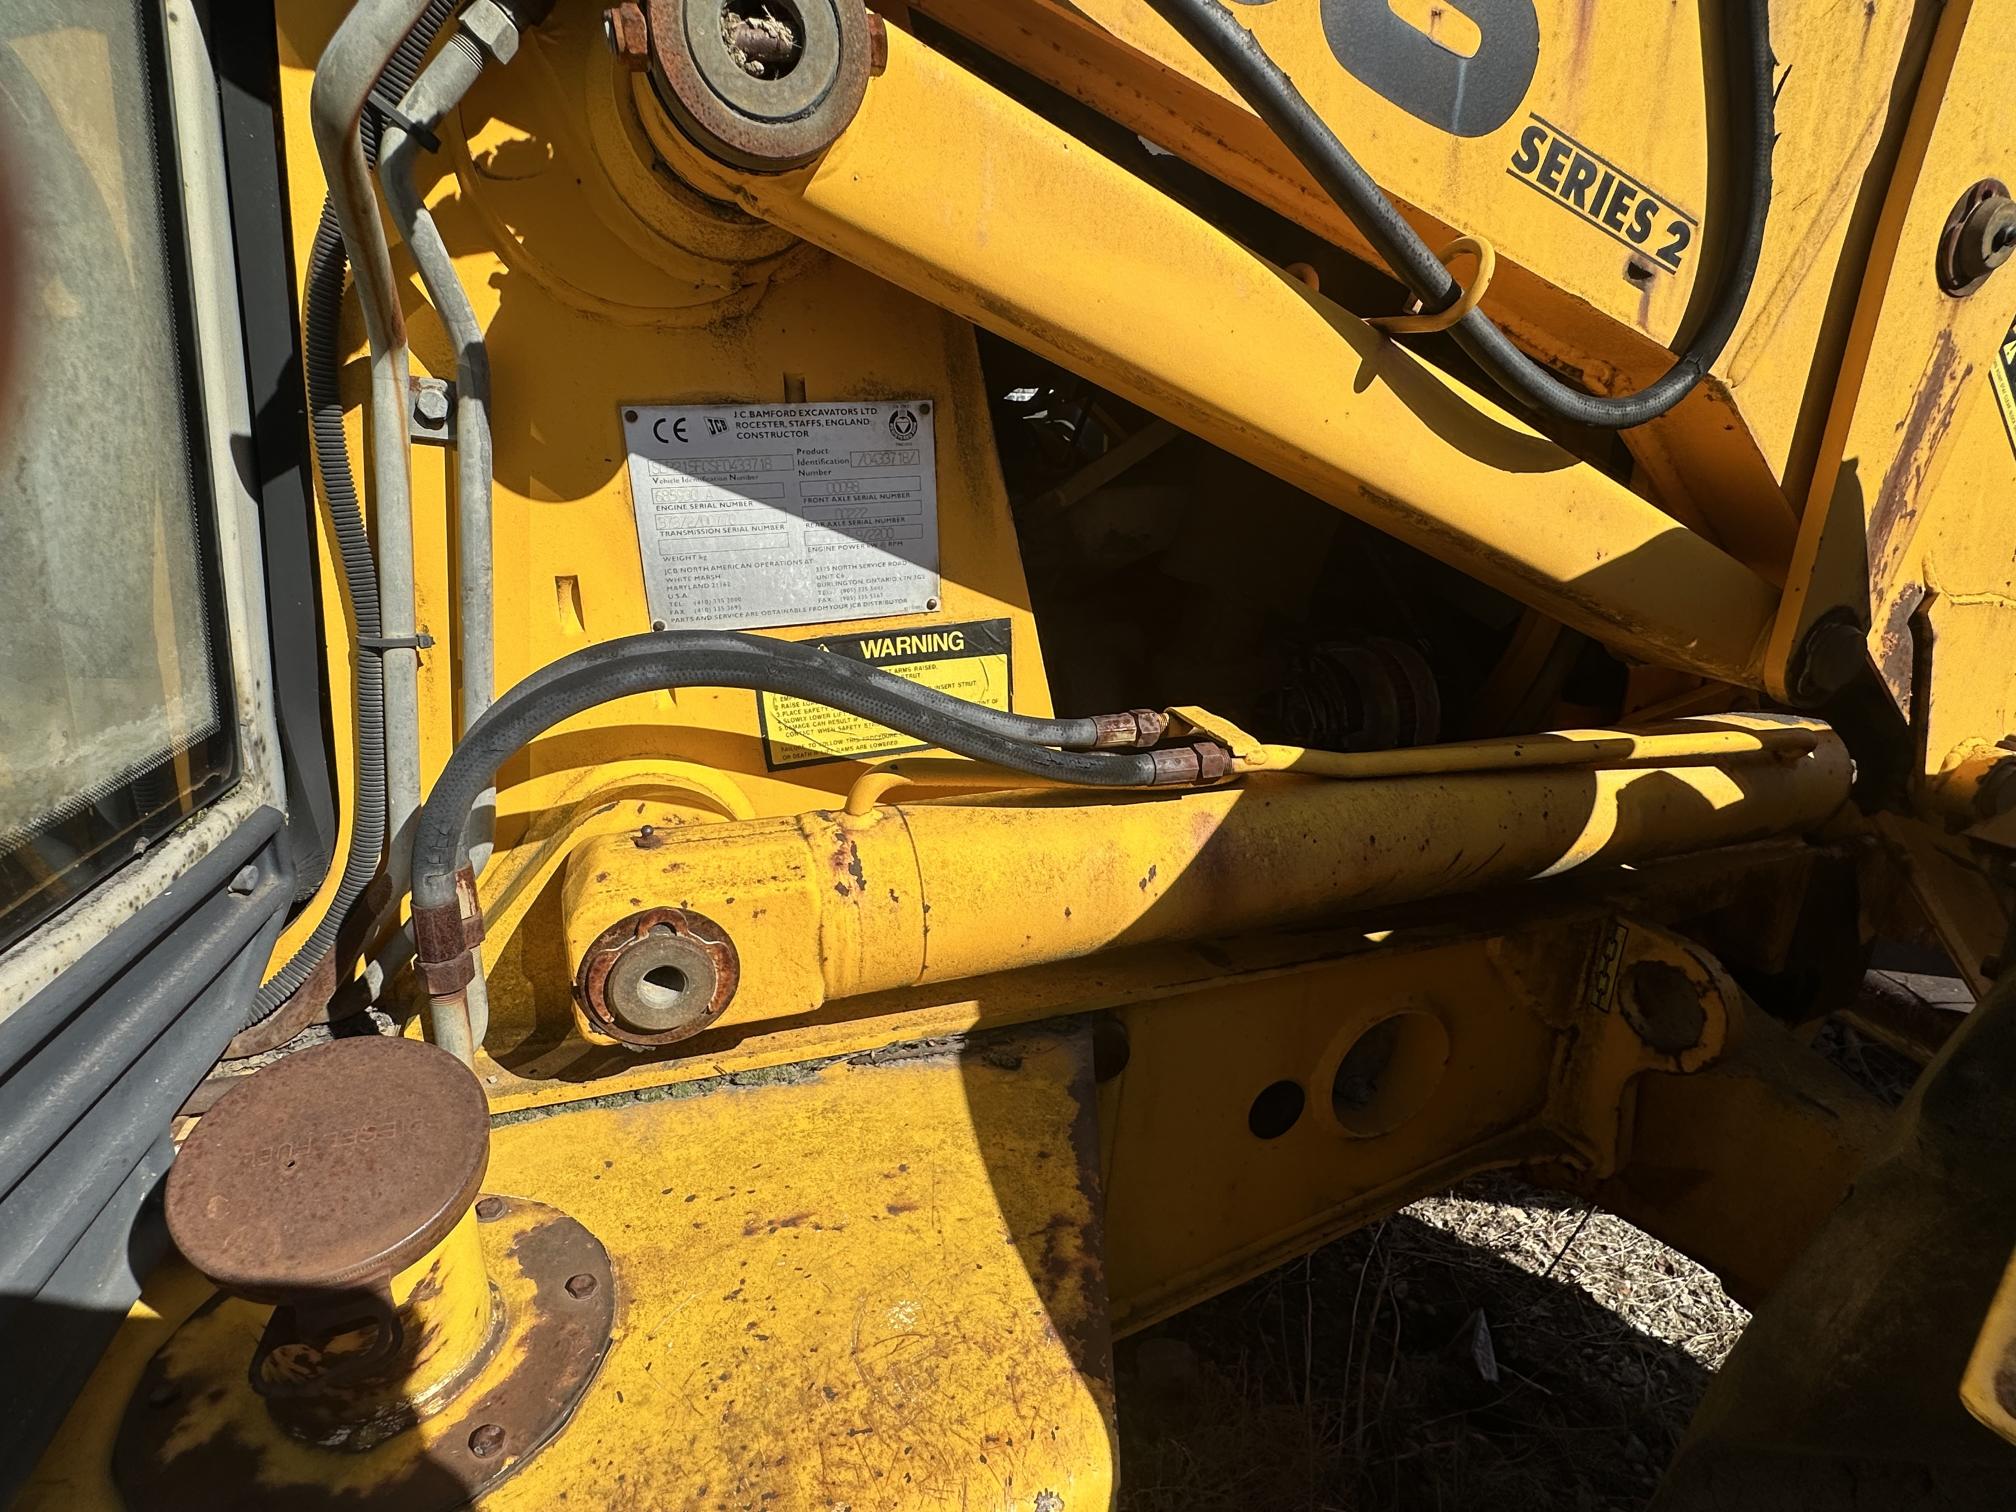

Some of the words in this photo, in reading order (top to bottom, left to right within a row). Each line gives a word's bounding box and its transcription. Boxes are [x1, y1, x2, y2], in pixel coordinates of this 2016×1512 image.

[1511, 125, 1660, 244] SERIES
[1655, 220, 1691, 266] 2
[749, 409, 797, 418] BAMFORD
[799, 407, 858, 417] EXCAVATORS
[860, 407, 878, 416] LTD
[706, 418, 728, 436] JCB
[825, 417, 870, 426] ENGLAND
[653, 417, 688, 444] CE
[736, 430, 810, 440] CONSTRUCTOR
[796, 447, 829, 455] Product
[797, 457, 850, 467] Identification
[652, 476, 680, 485] Vehicle
[729, 473, 759, 482] Number
[798, 469, 832, 478] Number
[803, 496, 829, 504] FRONT
[853, 493, 878, 501] SERIAL
[656, 504, 688, 512] ENGINE
[690, 502, 717, 510] SERIAL
[720, 500, 754, 508] NUMBER
[826, 520, 845, 528] AXLE
[848, 519, 872, 527] SERIAL
[875, 516, 905, 524] NUMBER
[660, 527, 721, 537] TRANSMISSION
[722, 525, 749, 534] SERIAL
[751, 524, 785, 532] NUMBER
[807, 545, 835, 553] ENGINE
[680, 565, 709, 573] NORTH
[711, 562, 752, 570] AMERICAN
[754, 559, 803, 568] OPERATIONS
[859, 561, 885, 569] SERVICE
[666, 583, 710, 591] MARYLAND
[714, 612, 743, 620] SERVICE
[760, 607, 807, 616] OBTAINABLE
[863, 598, 907, 607] DISTRIBUTOR
[860, 631, 965, 660] WARNING
[894, 666, 912, 674] ARMS
[957, 680, 976, 688] STRUT
[780, 701, 800, 709] RAISE
[804, 706, 828, 714] SAFETY
[783, 716, 807, 724] SLOWLY
[809, 712, 831, 720] LOWER
[827, 717, 851, 725] RESULT
[793, 751, 810, 759] DEATH
[870, 740, 898, 748] LOWERED
[323, 1119, 424, 1148] DIESEL
[244, 1135, 312, 1167] FUEL
